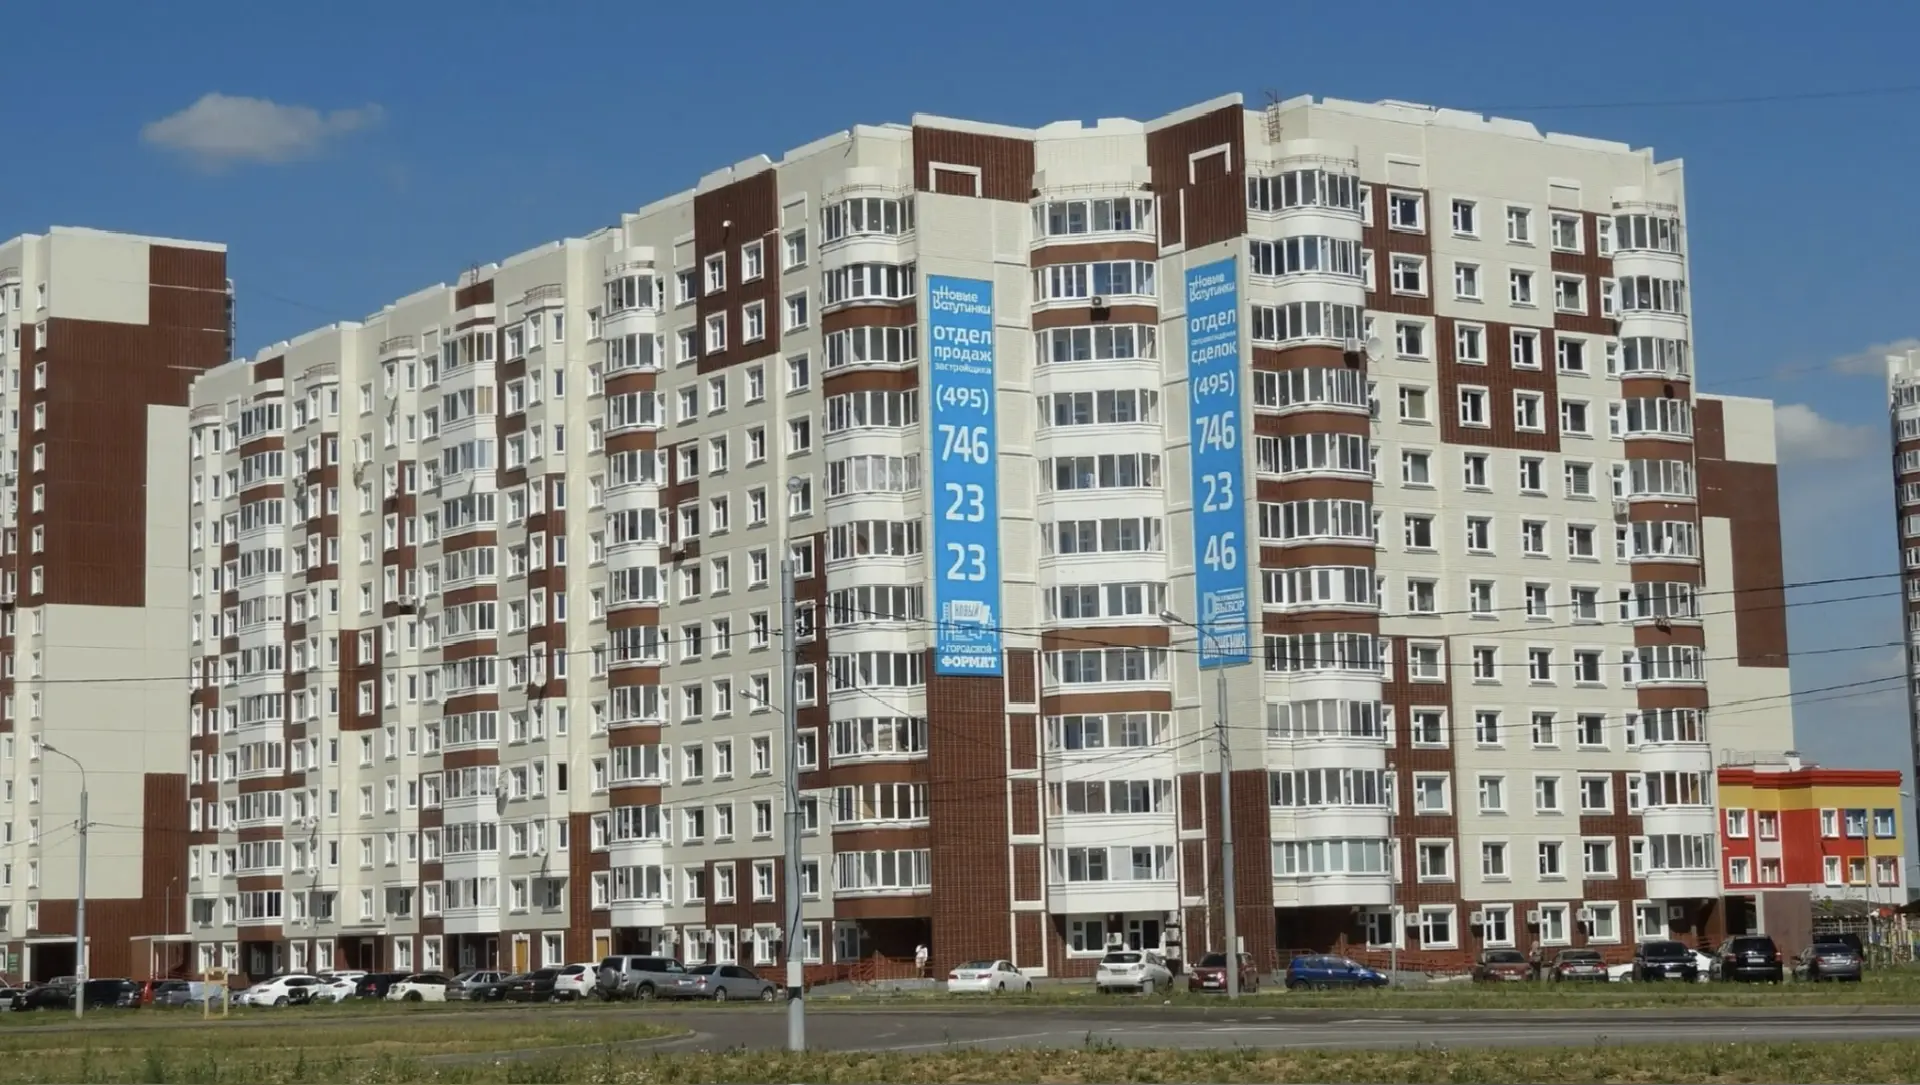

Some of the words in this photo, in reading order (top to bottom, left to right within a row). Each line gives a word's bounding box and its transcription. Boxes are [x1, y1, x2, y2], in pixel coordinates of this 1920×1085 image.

[932, 285, 978, 303] Новые
[1191, 308, 1236, 333] отдел
[934, 345, 992, 362] продаж
[1191, 340, 1237, 365] сделок
[936, 384, 989, 415] (495)
[1193, 369, 1235, 405] (495)
[938, 424, 989, 464] 746
[1196, 410, 1236, 454] 746
[945, 482, 985, 523] 23
[1202, 471, 1234, 513] 23
[947, 542, 987, 582] 23
[1203, 531, 1237, 572] 46
[941, 655, 997, 668] ФОРМАТ
